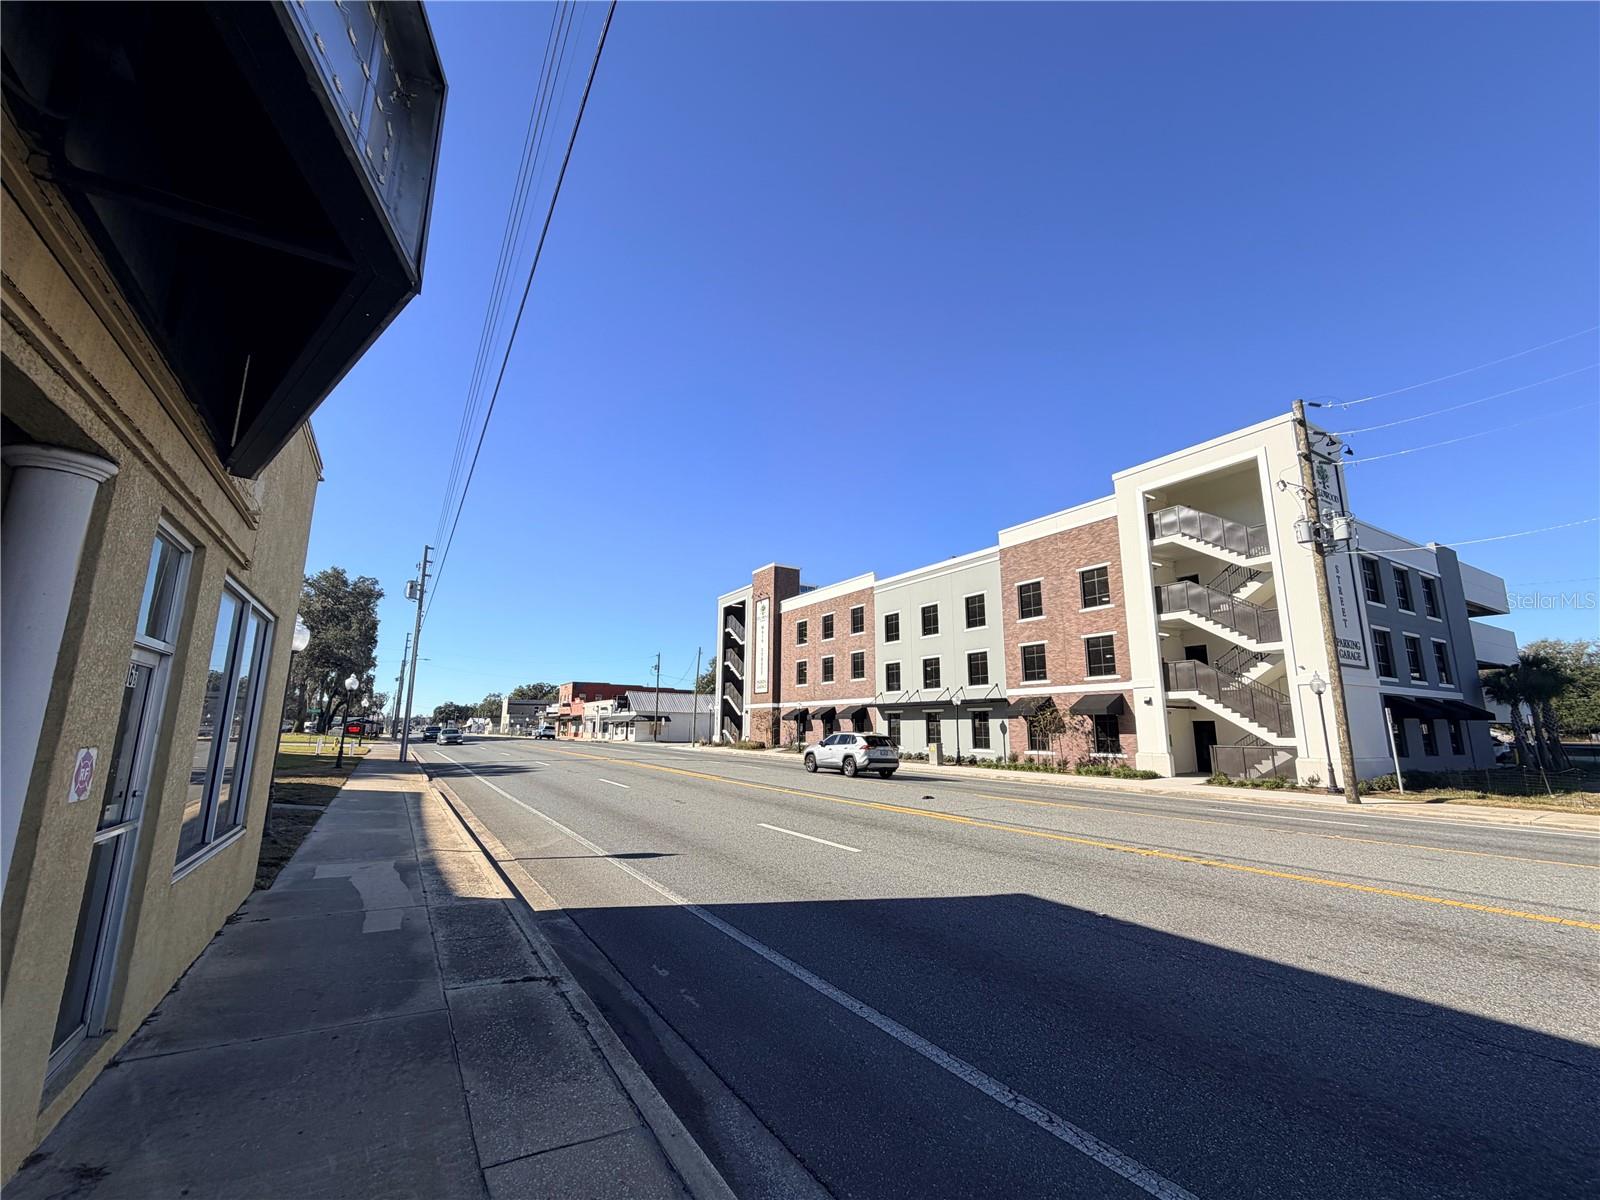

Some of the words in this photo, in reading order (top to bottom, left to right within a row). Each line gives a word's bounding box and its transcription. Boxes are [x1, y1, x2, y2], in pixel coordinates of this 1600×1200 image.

[1335, 565, 1348, 628] STREET
[1336, 637, 1361, 651] PARKING
[1339, 648, 1363, 661] GARAGE
